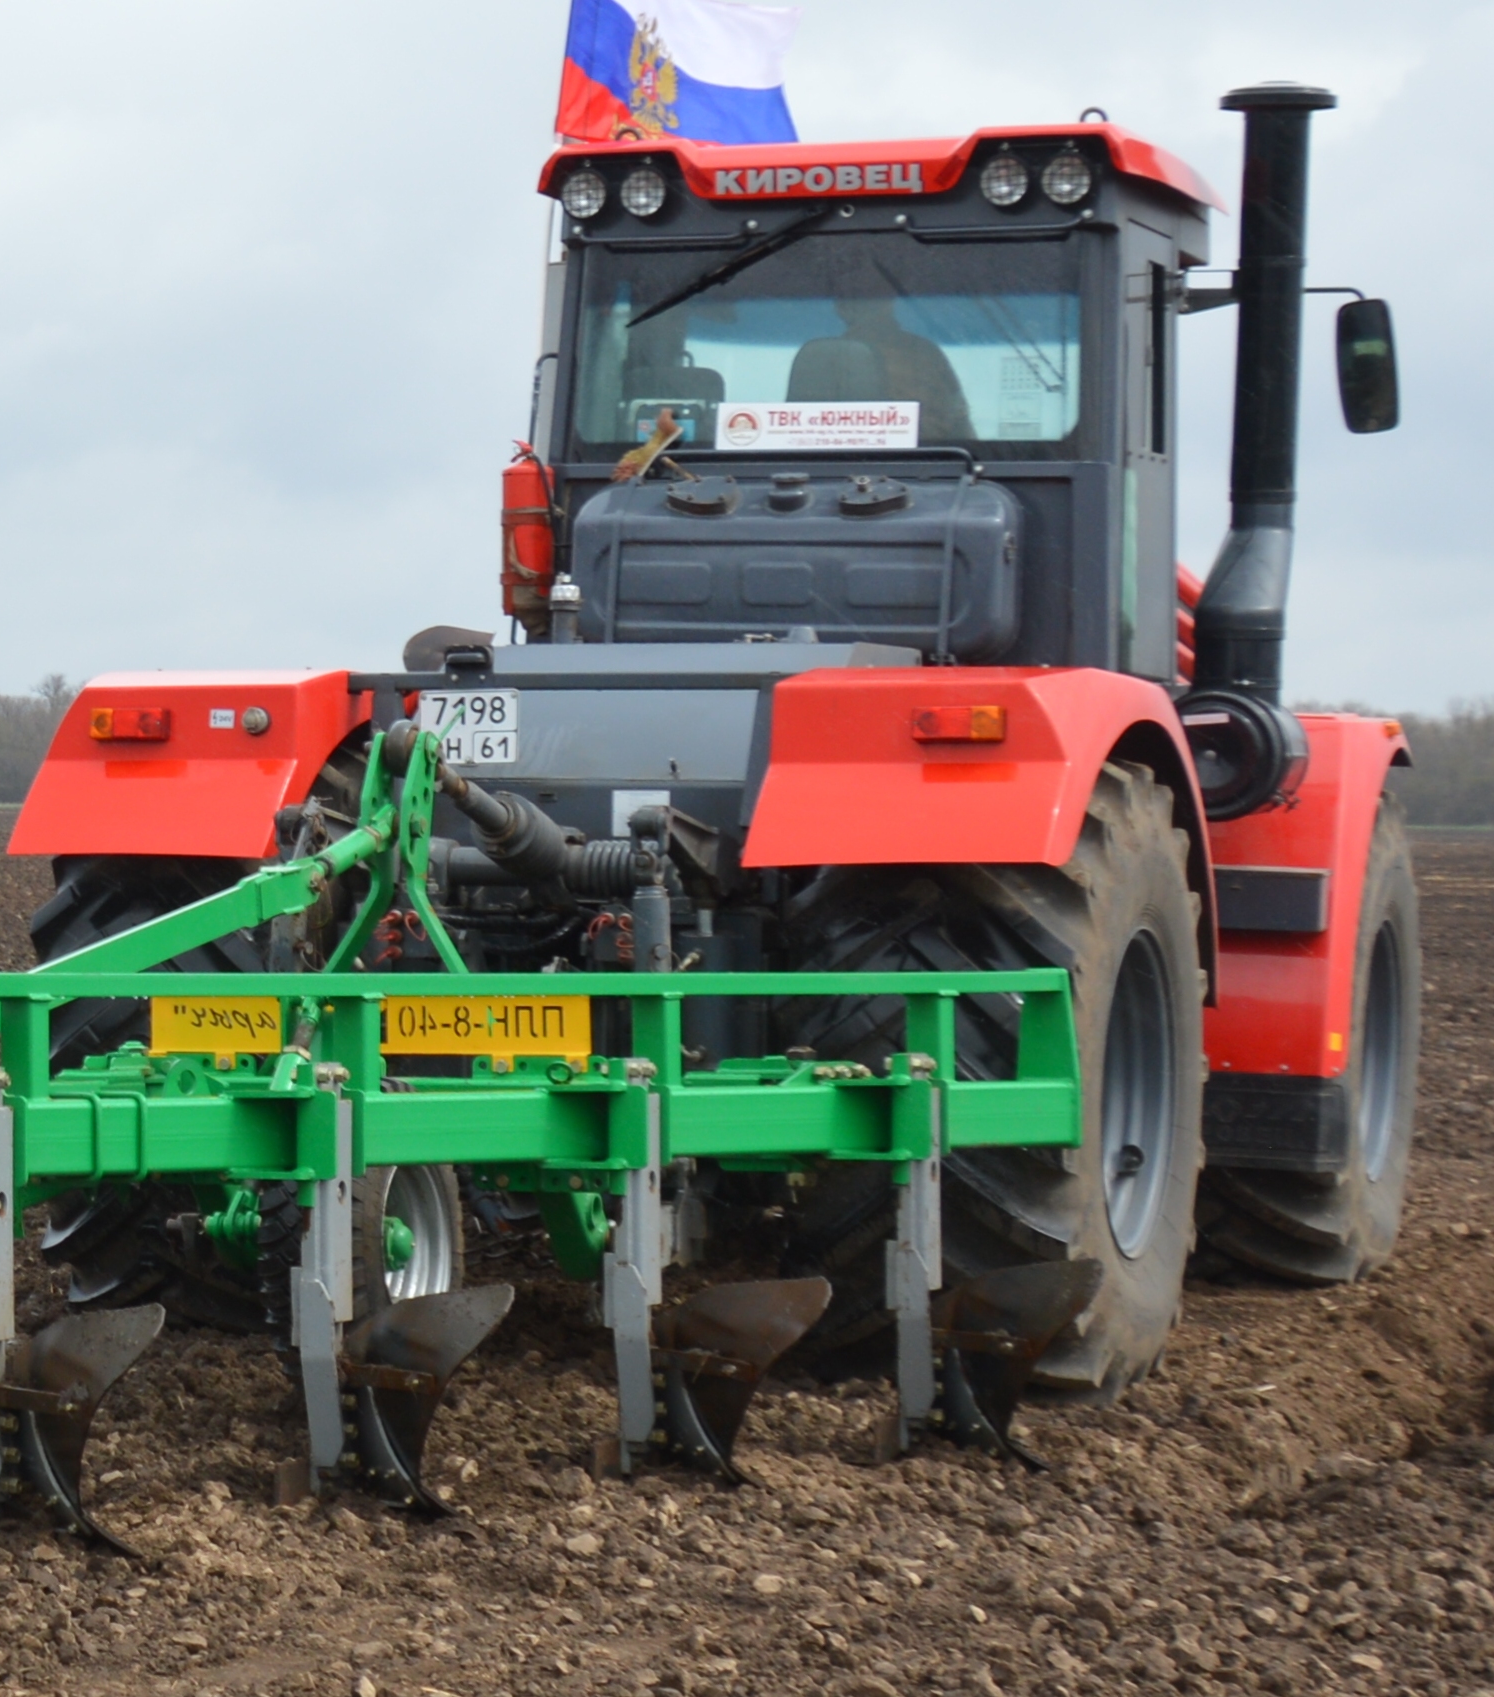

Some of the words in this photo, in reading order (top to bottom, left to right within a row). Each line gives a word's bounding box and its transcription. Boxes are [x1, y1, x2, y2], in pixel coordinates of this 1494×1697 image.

[715, 163, 923, 195] КИРОВЕЦ
[767, 411, 802, 426] ТВК
[808, 406, 910, 427] «ЮЖНЫЙ»
[432, 696, 506, 725] 7198
[481, 737, 509, 758] 61
